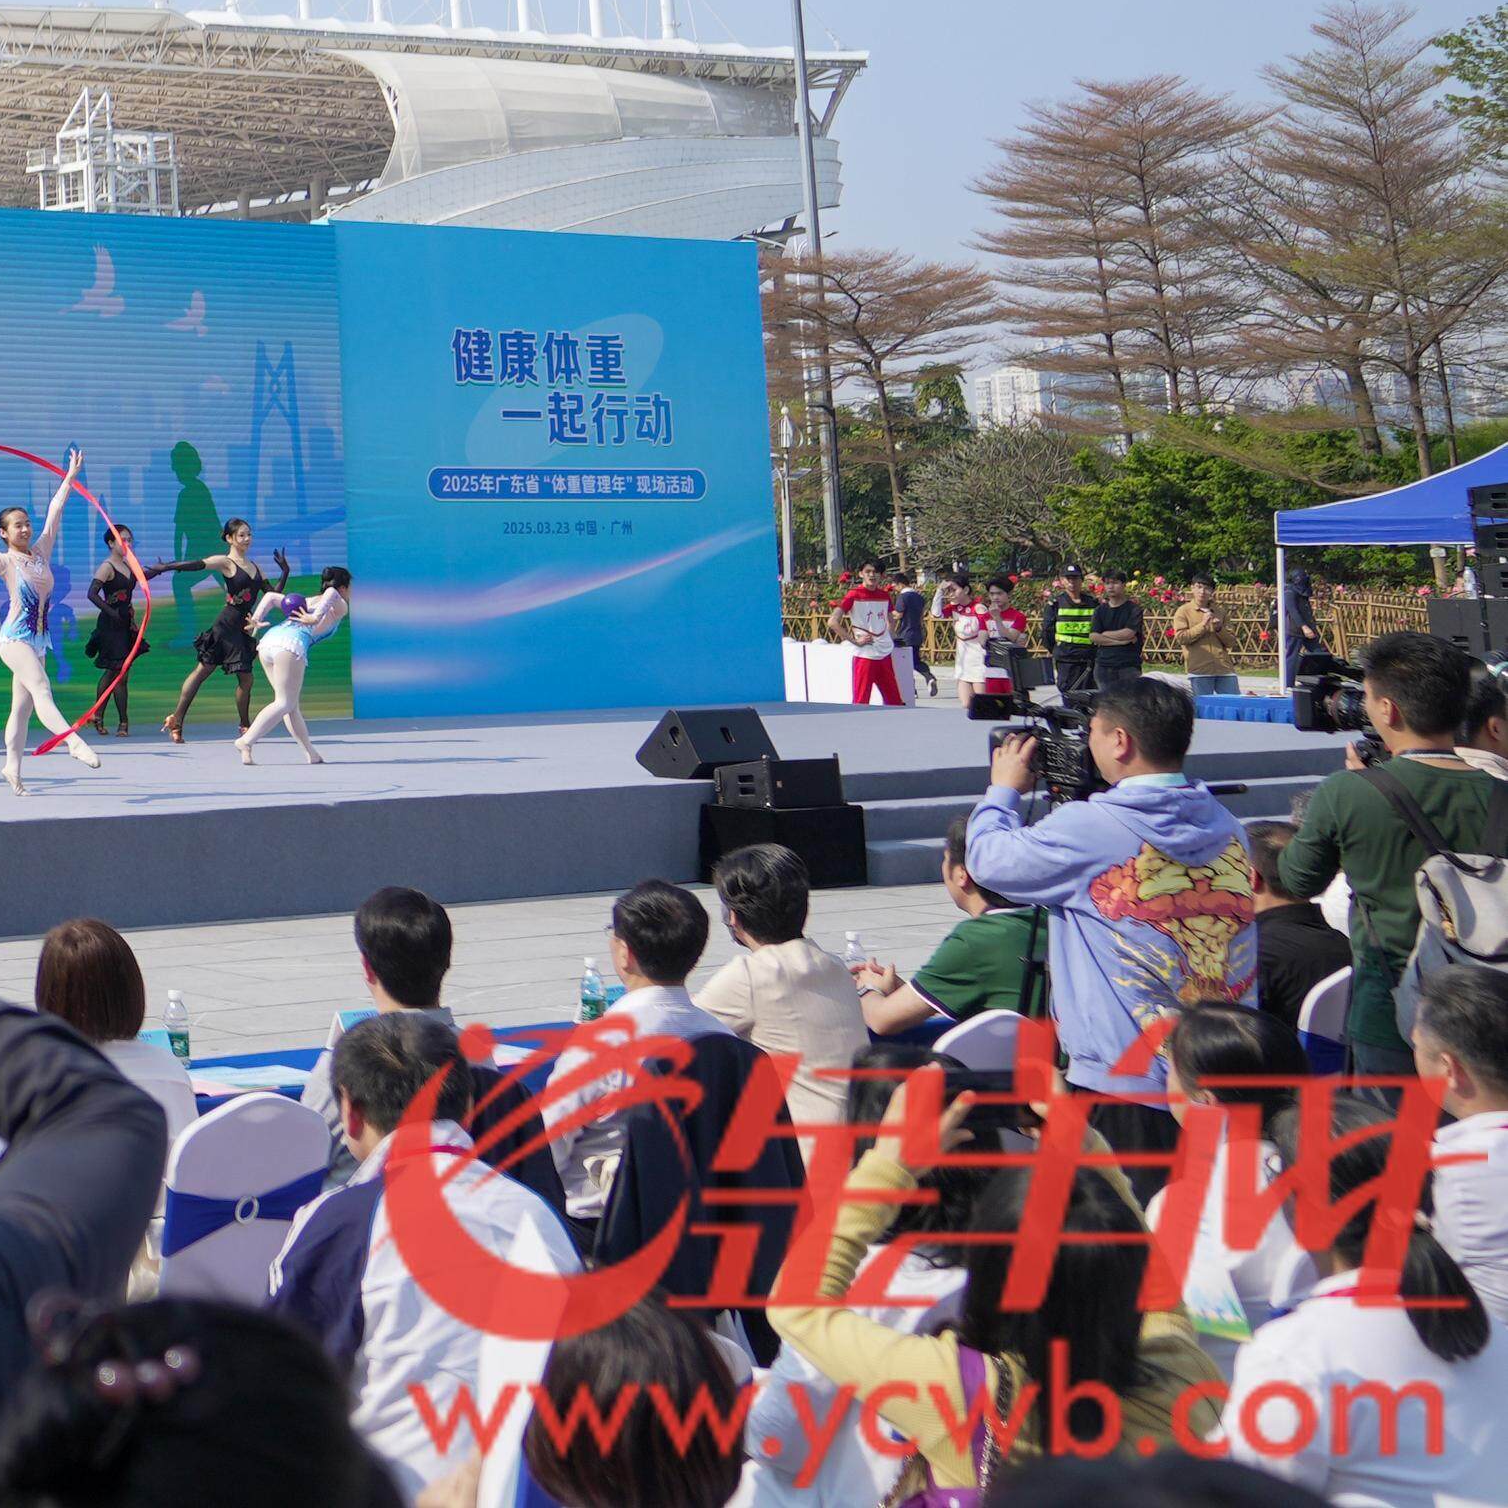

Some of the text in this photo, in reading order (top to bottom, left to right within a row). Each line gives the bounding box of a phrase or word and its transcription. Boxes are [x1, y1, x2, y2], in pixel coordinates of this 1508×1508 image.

[451, 328, 626, 386] 健康体重
[501, 392, 674, 446] 一起行动
[503, 521, 570, 535] 2025.03.23
